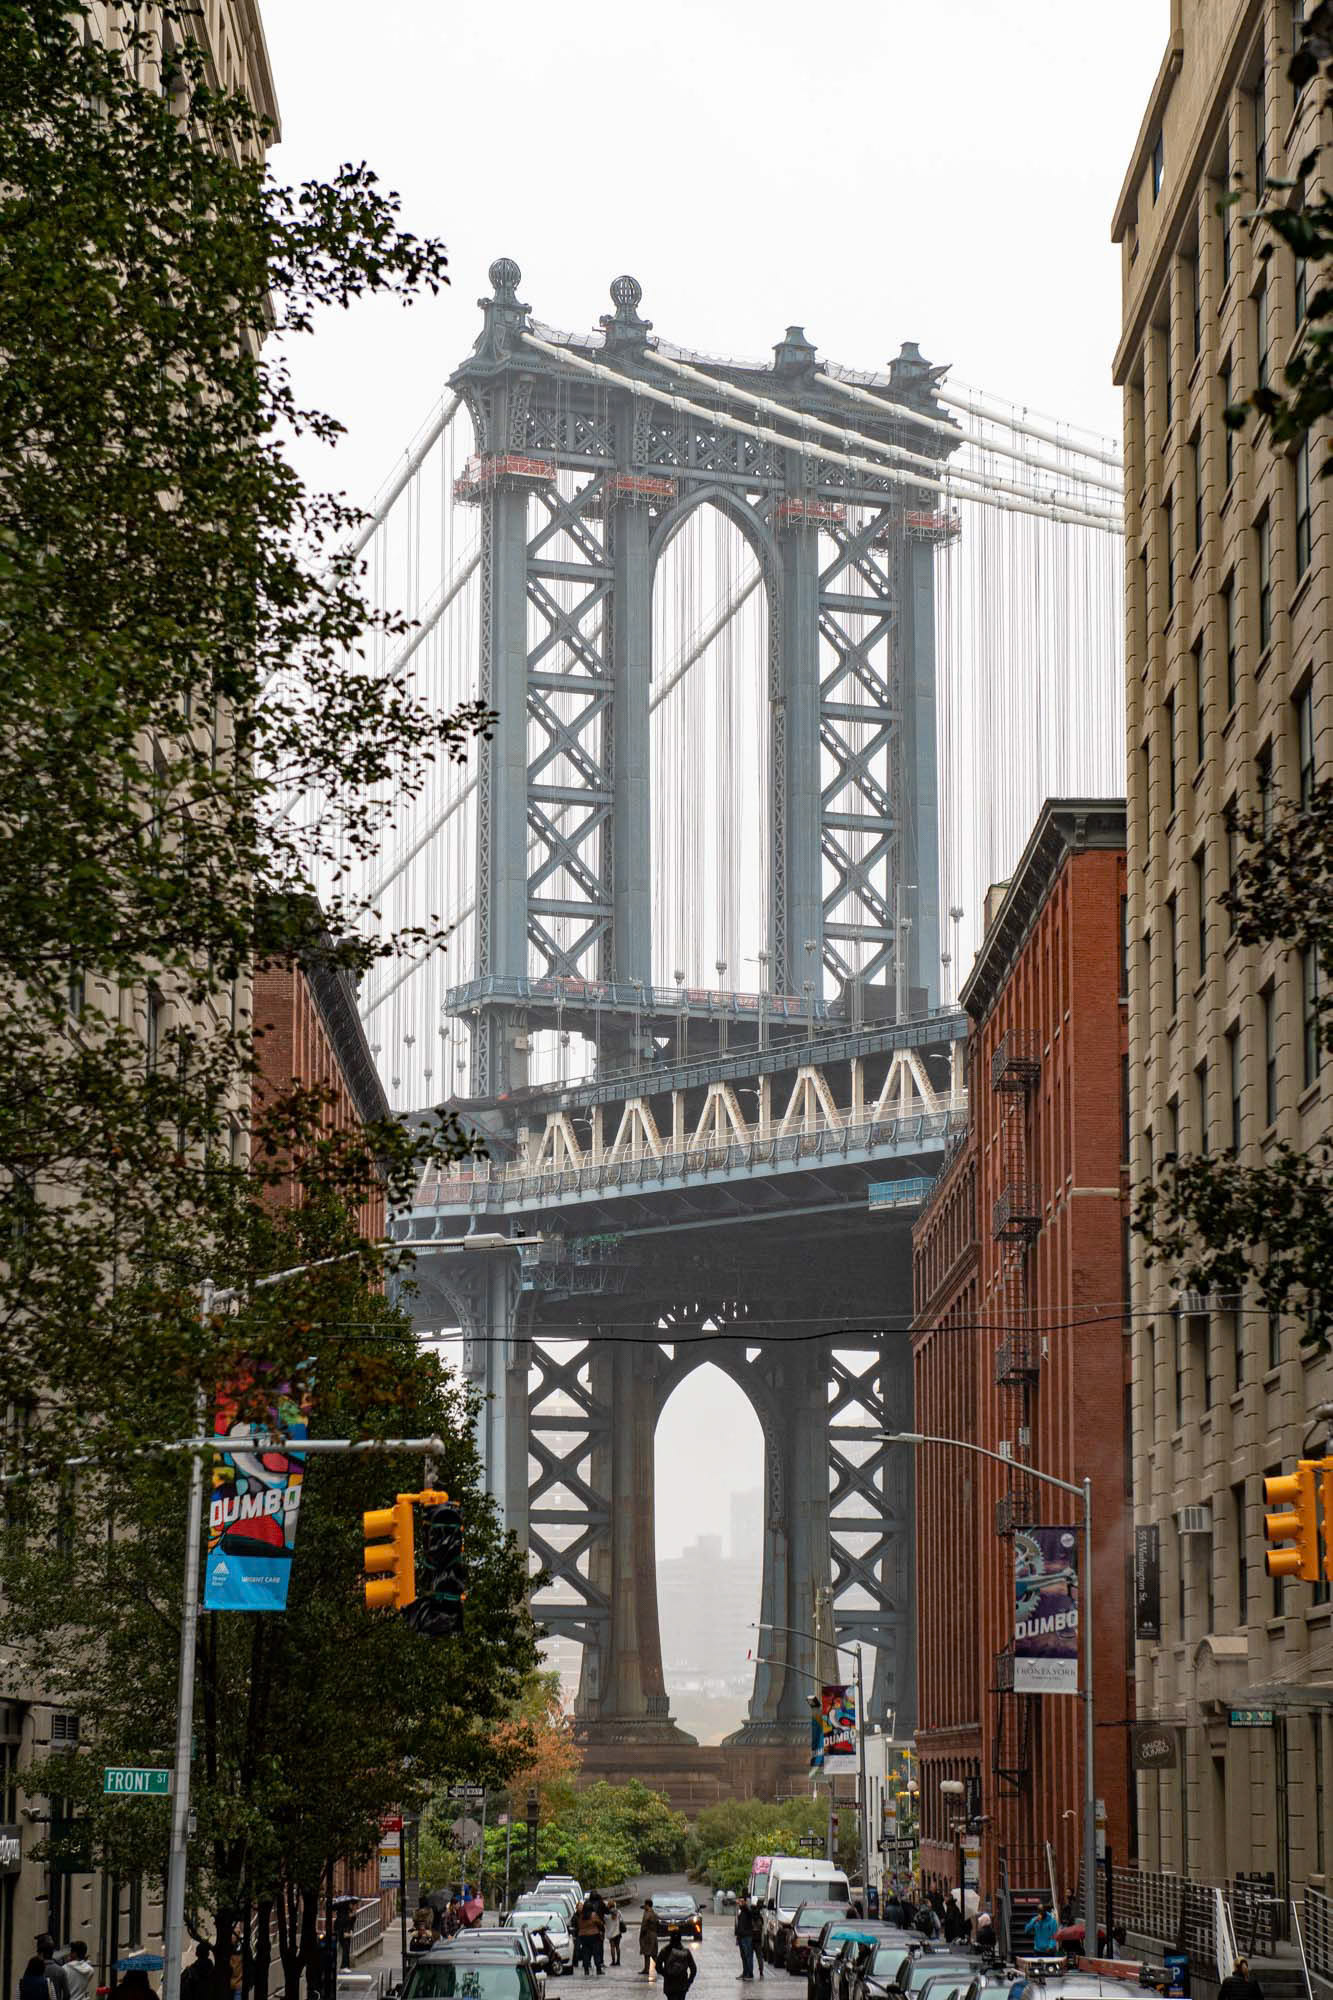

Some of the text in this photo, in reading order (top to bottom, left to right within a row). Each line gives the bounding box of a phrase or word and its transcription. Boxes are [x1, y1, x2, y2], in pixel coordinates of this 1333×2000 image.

[209, 1484, 302, 1528] DUMBO
[1137, 1542, 1148, 1590] Washington
[1015, 1610, 1078, 1641] DUMBO
[824, 1729, 857, 1747] DUMBO
[107, 1771, 167, 1791] FRONT ST
